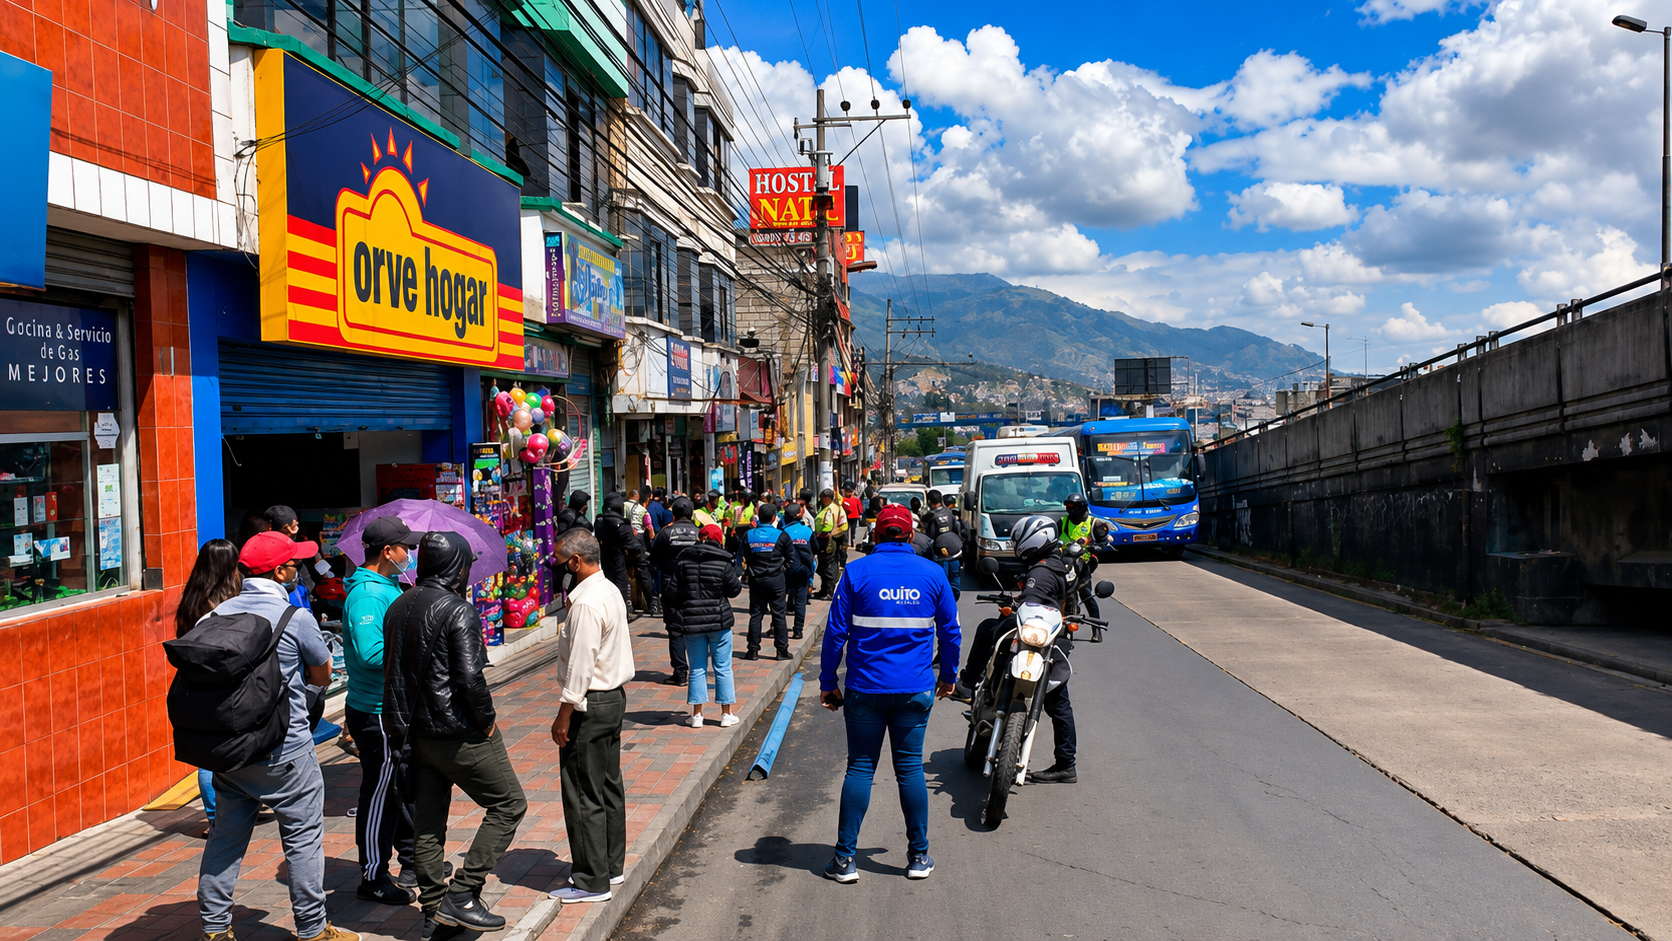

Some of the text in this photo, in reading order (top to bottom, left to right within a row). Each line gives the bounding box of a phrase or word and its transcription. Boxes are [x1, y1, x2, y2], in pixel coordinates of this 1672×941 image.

[755, 170, 840, 194] HOSTL
[353, 240, 418, 313] orve
[424, 246, 488, 339] hogar
[55, 323, 64, 339] &
[67, 323, 112, 344] Servicio
[40, 341, 80, 361] de Gas
[8, 363, 106, 385] MEJORES
